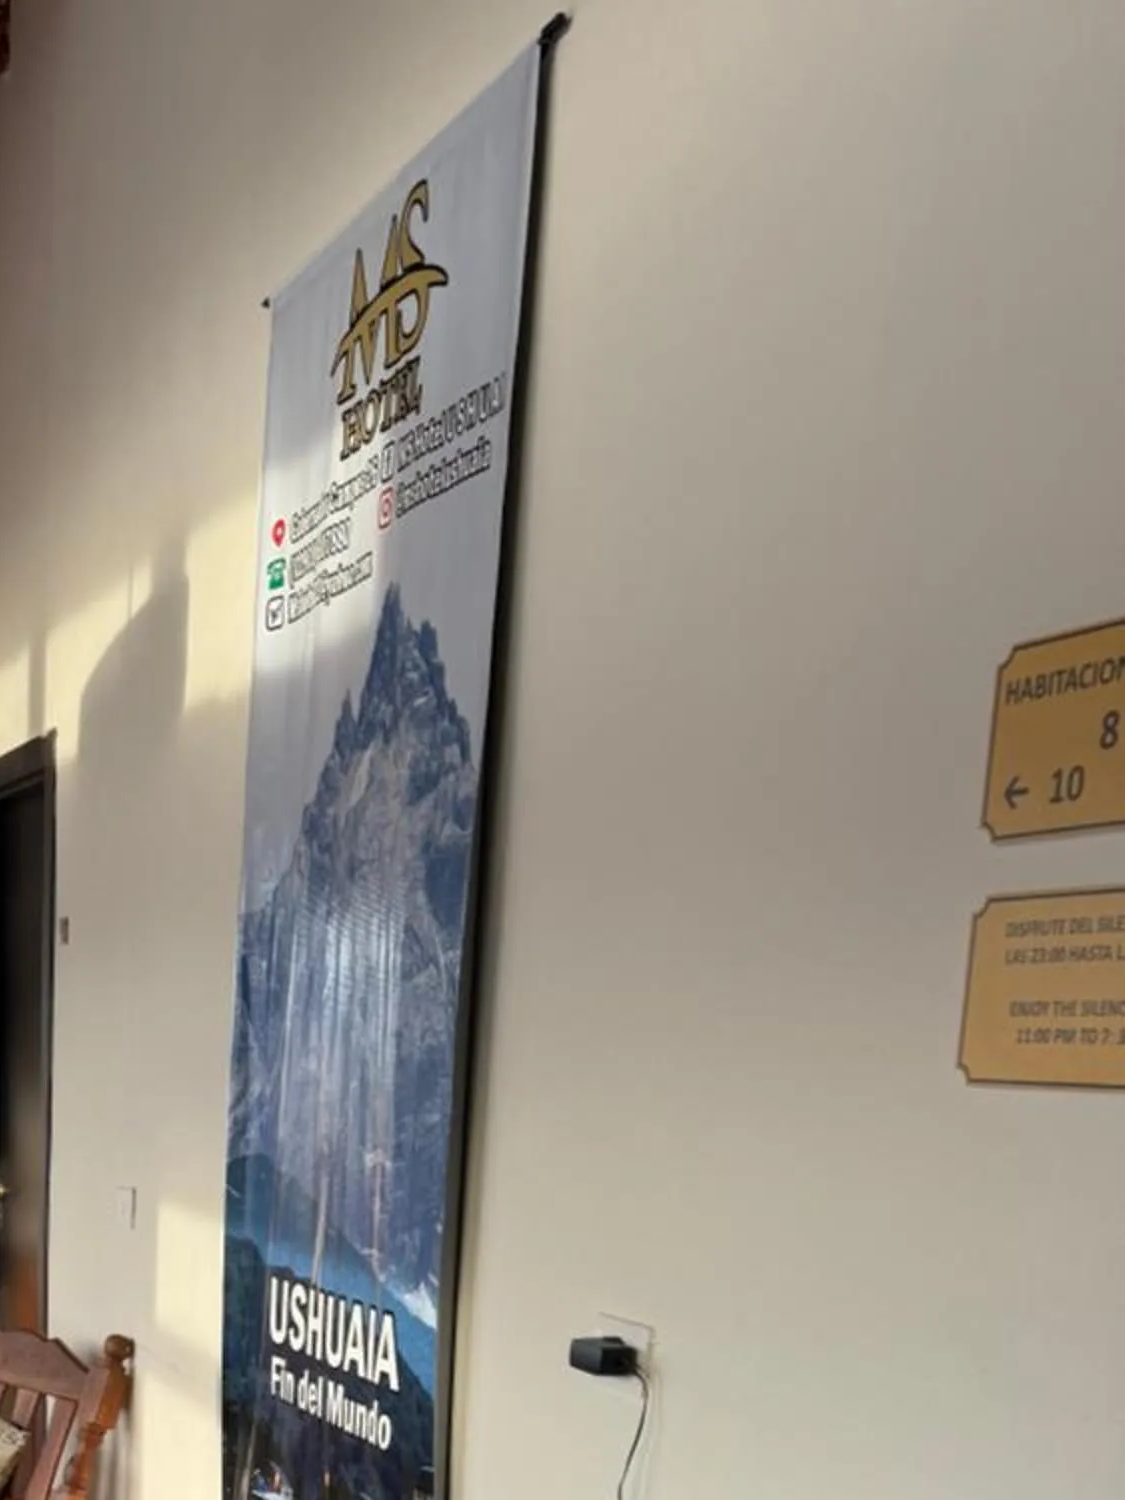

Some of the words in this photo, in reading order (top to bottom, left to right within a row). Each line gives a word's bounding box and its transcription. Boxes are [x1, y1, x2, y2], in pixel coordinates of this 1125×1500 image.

[339, 355, 423, 462] HOTEL
[1100, 709, 1121, 750] 8
[1049, 765, 1086, 804] 10
[1068, 944, 1113, 962] HASTA
[1053, 1000, 1077, 1018] THE
[269, 1276, 399, 1393] USHUAIA
[271, 1355, 295, 1404] Fin
[297, 1369, 324, 1419] del
[325, 1379, 392, 1452] Mundo
